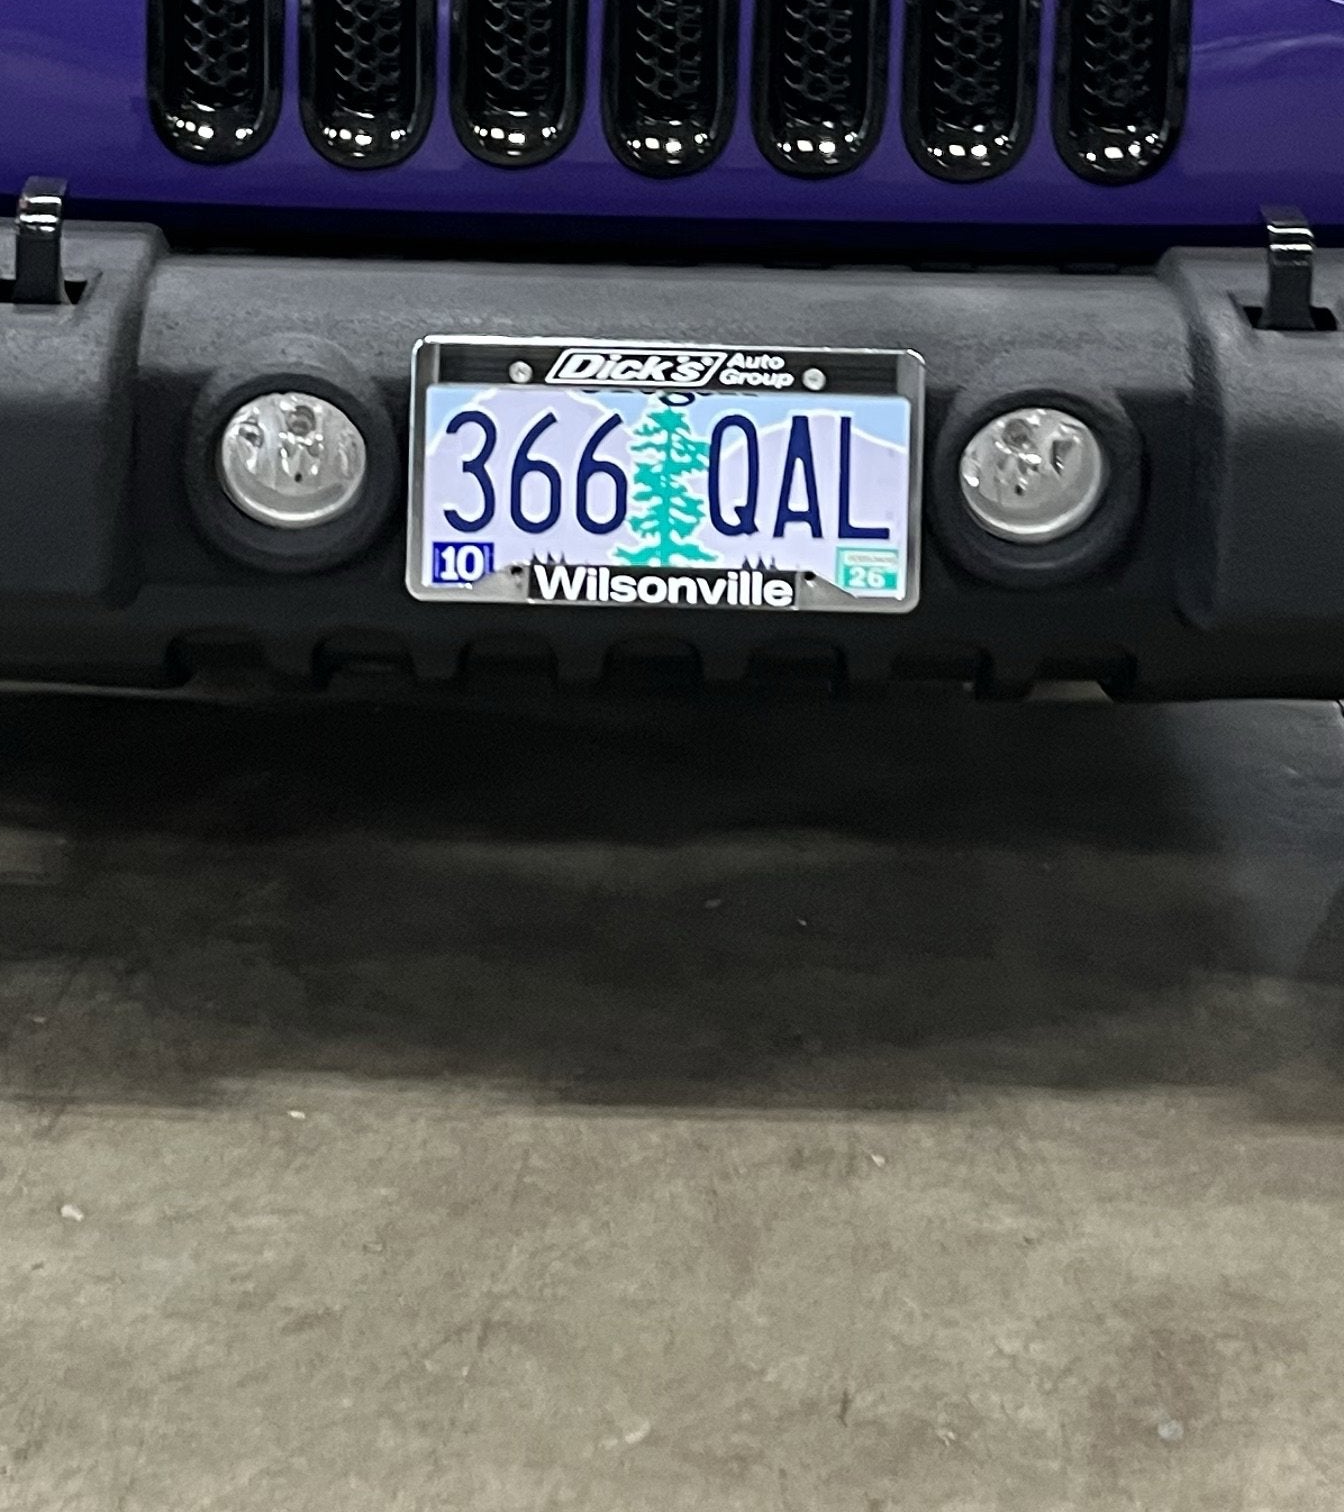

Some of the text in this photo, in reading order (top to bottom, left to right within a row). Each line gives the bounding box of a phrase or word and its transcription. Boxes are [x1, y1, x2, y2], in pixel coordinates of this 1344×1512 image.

[557, 353, 785, 383] Dick's Auto
[718, 368, 795, 389] Group
[443, 410, 891, 540] 366 QAL
[440, 545, 484, 581] 10
[849, 566, 886, 588] 26
[533, 565, 794, 607] Wilsonville
